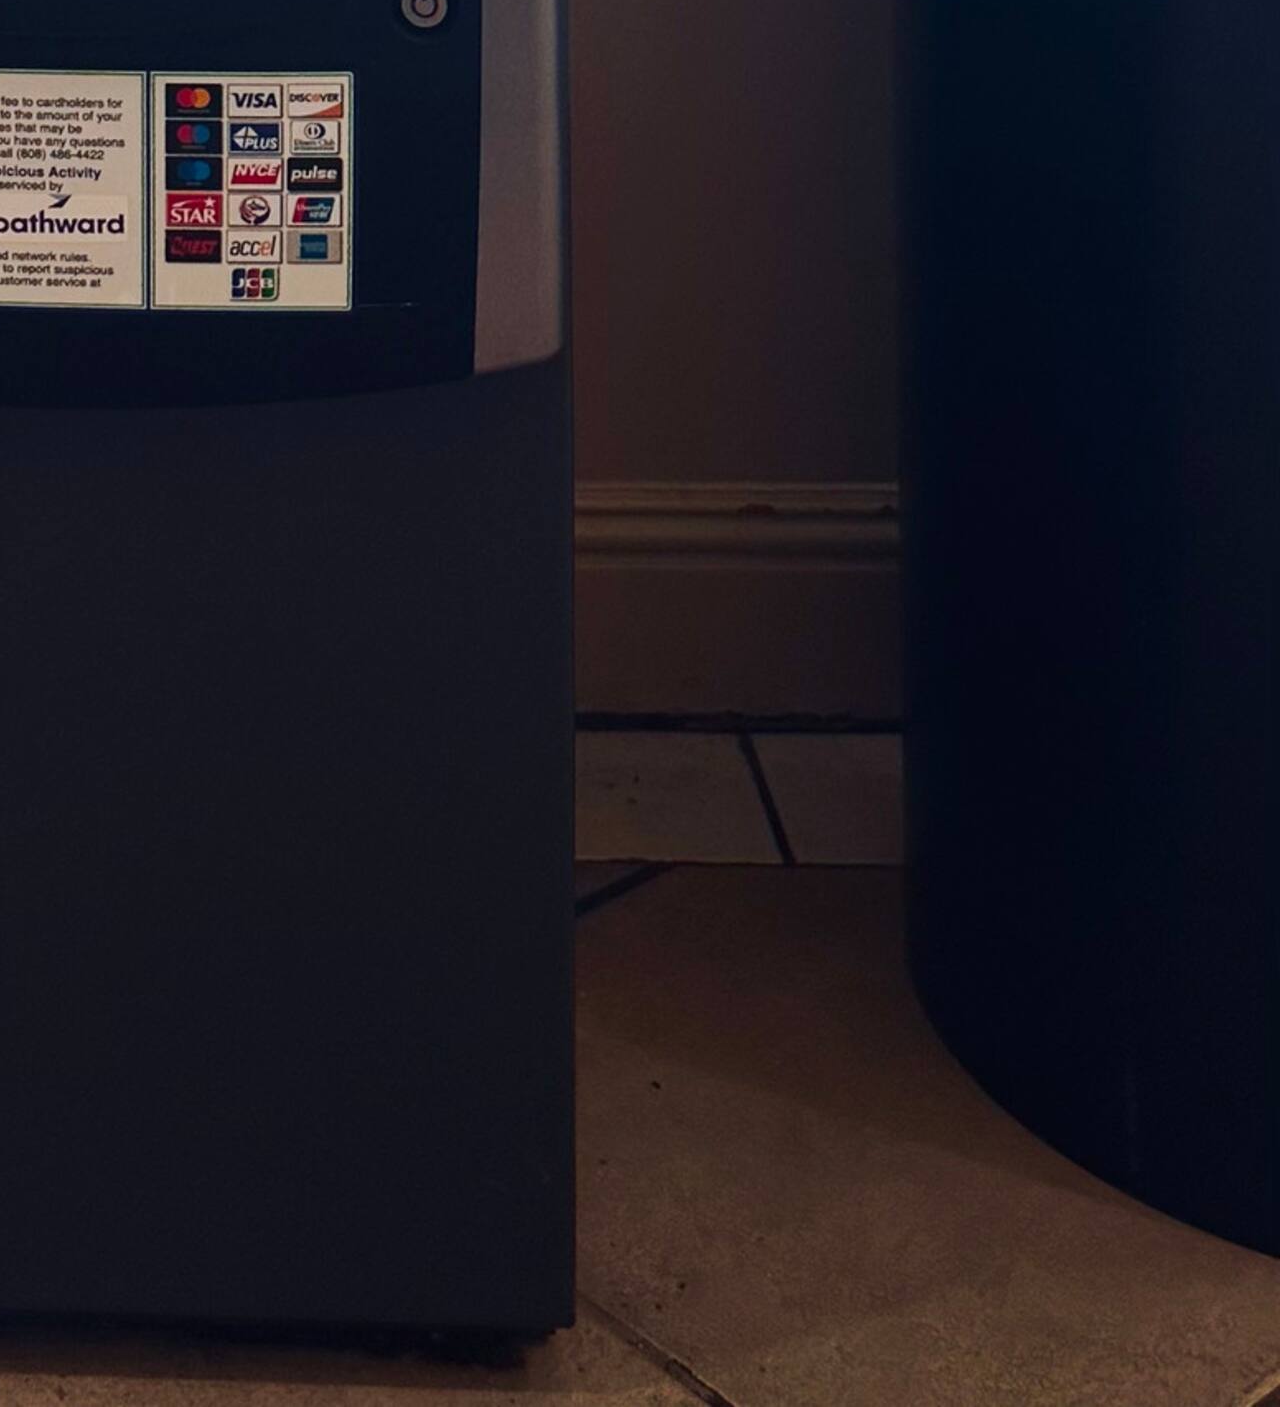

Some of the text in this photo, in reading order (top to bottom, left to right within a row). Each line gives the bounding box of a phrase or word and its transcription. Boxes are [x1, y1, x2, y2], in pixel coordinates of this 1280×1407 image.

[1, 96, 19, 106] fee
[22, 97, 33, 106] to
[36, 97, 104, 108] cardholders
[107, 98, 123, 108] for
[232, 92, 278, 108] VISA
[289, 93, 339, 103] DISCOVER
[0, 109, 11, 119] to
[14, 109, 33, 120] the
[36, 111, 79, 121] amount
[82, 111, 94, 121] of
[96, 112, 123, 123] your
[14, 122, 36, 133] that
[39, 124, 65, 135] may
[68, 124, 82, 134] be
[14, 136, 42, 146] have
[45, 138, 66, 148] any
[69, 138, 125, 149] questions
[244, 137, 278, 150] PLUS
[17, 149, 46, 161] (808)
[50, 150, 105, 160] 486-4422
[48, 166, 102, 181] Activity
[235, 164, 278, 177] NYCE
[290, 164, 338, 182] pulse
[49, 181, 64, 193] by
[171, 208, 216, 223] STAR
[230, 235, 277, 256] accel
[11, 251, 56, 261] network
[60, 252, 91, 262] rules.
[2, 263, 14, 273] to
[17, 264, 51, 275] report
[54, 265, 114, 276] suspicious
[46, 277, 86, 287] service
[89, 278, 101, 287] at
